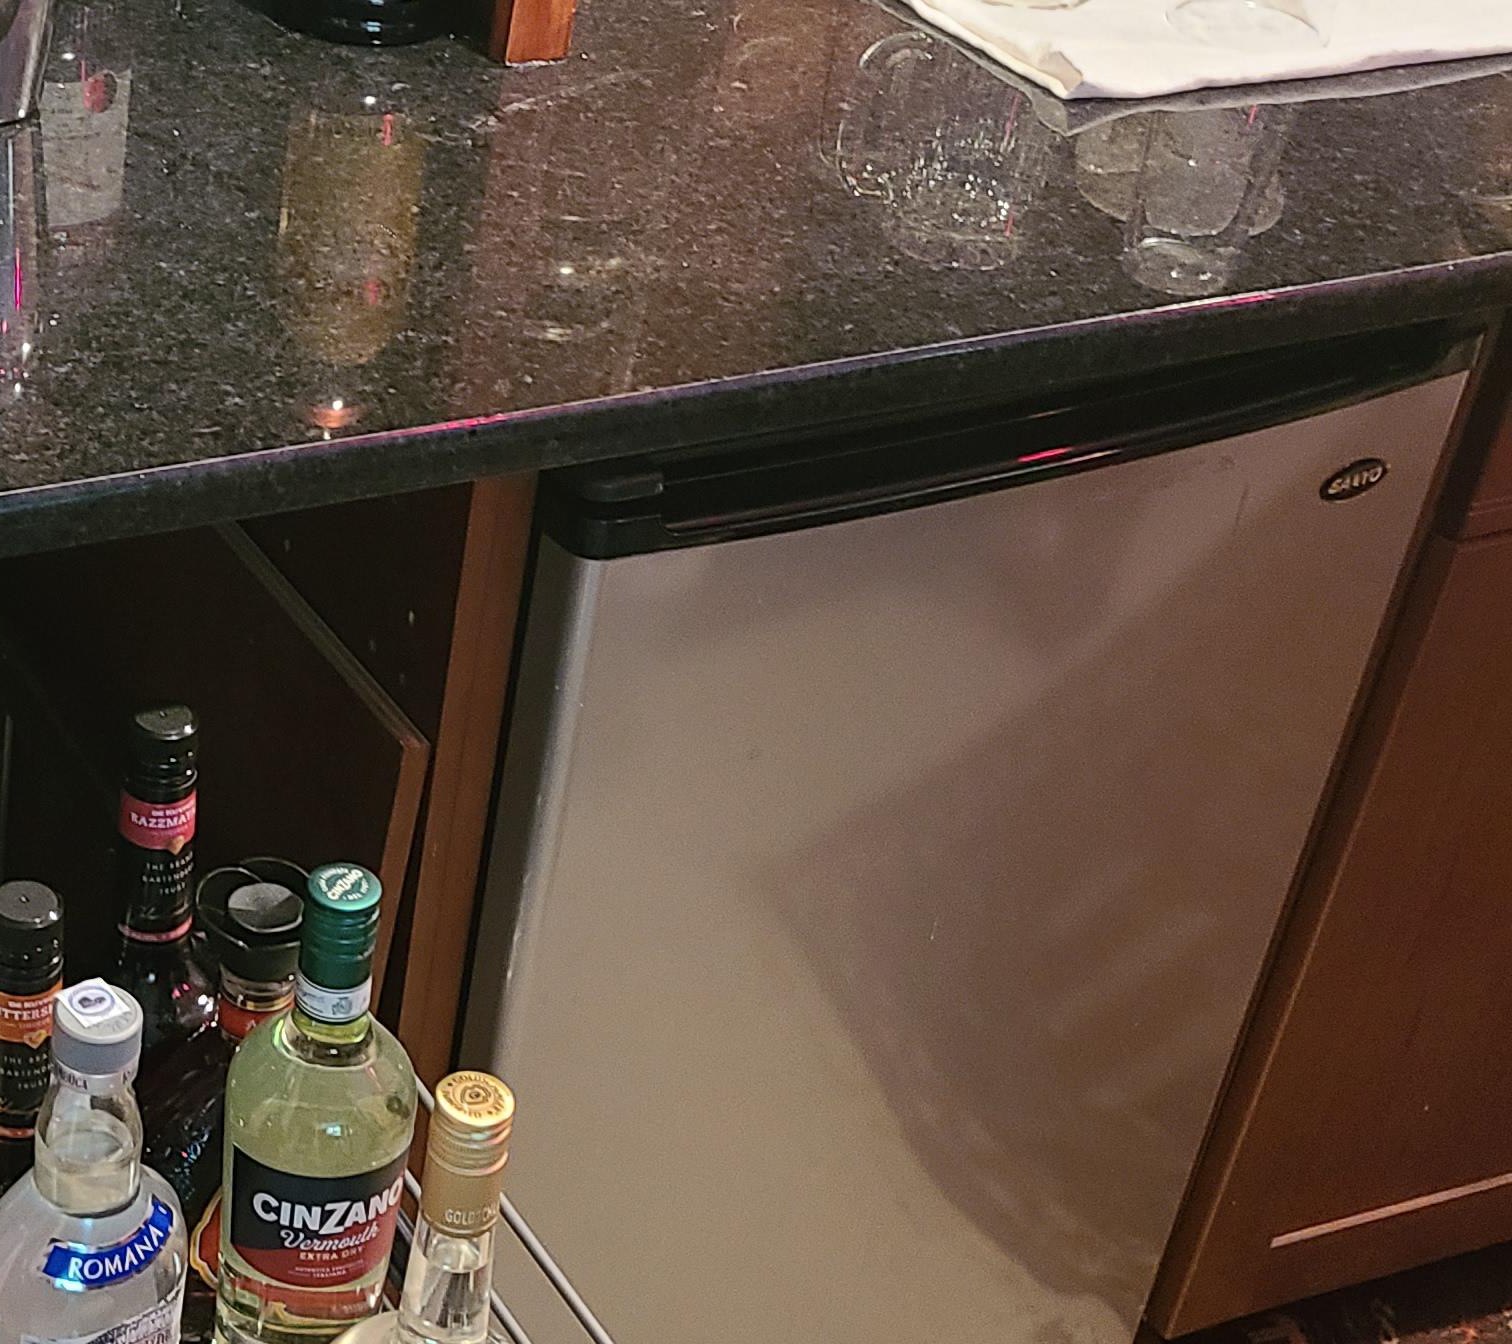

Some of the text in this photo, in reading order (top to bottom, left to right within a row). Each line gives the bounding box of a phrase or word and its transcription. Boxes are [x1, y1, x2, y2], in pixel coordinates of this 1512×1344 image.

[326, 868, 364, 901] CINZANO
[252, 1176, 404, 1235] CINZANO
[68, 1223, 165, 1281] ROMANA
[280, 1220, 380, 1252] Vermouth
[299, 1245, 365, 1261] EXTRA DRY
